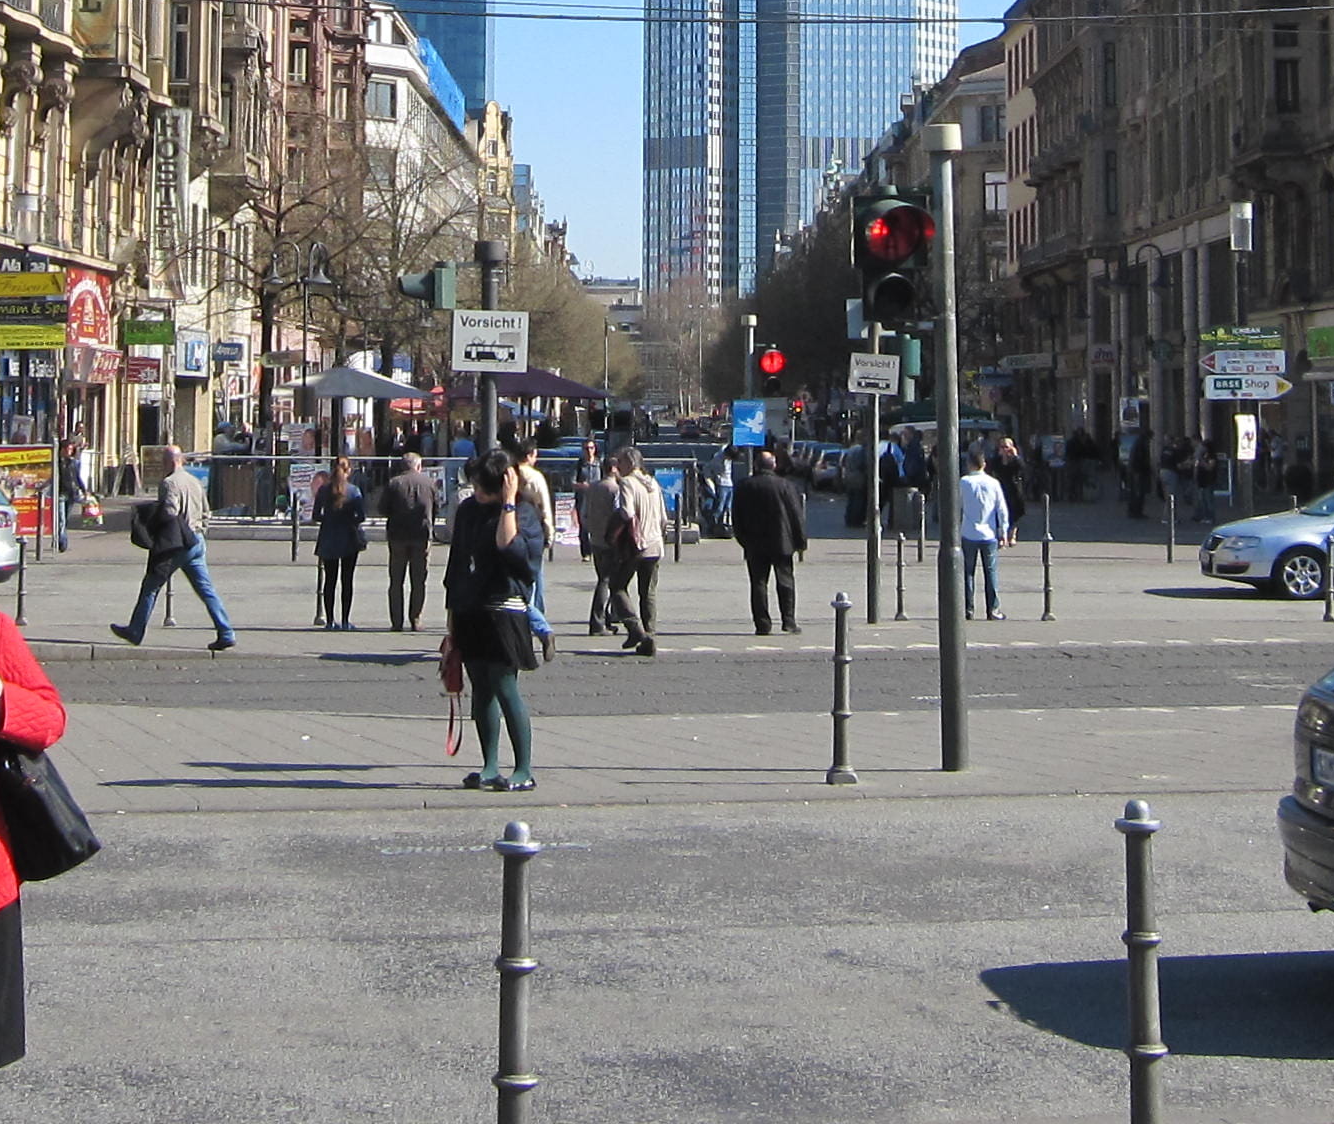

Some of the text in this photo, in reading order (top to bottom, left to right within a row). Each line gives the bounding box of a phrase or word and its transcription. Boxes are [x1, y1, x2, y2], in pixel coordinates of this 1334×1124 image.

[32, 303, 40, 314] &
[45, 302, 67, 316] Spa
[1215, 379, 1269, 390] BASE Shop
